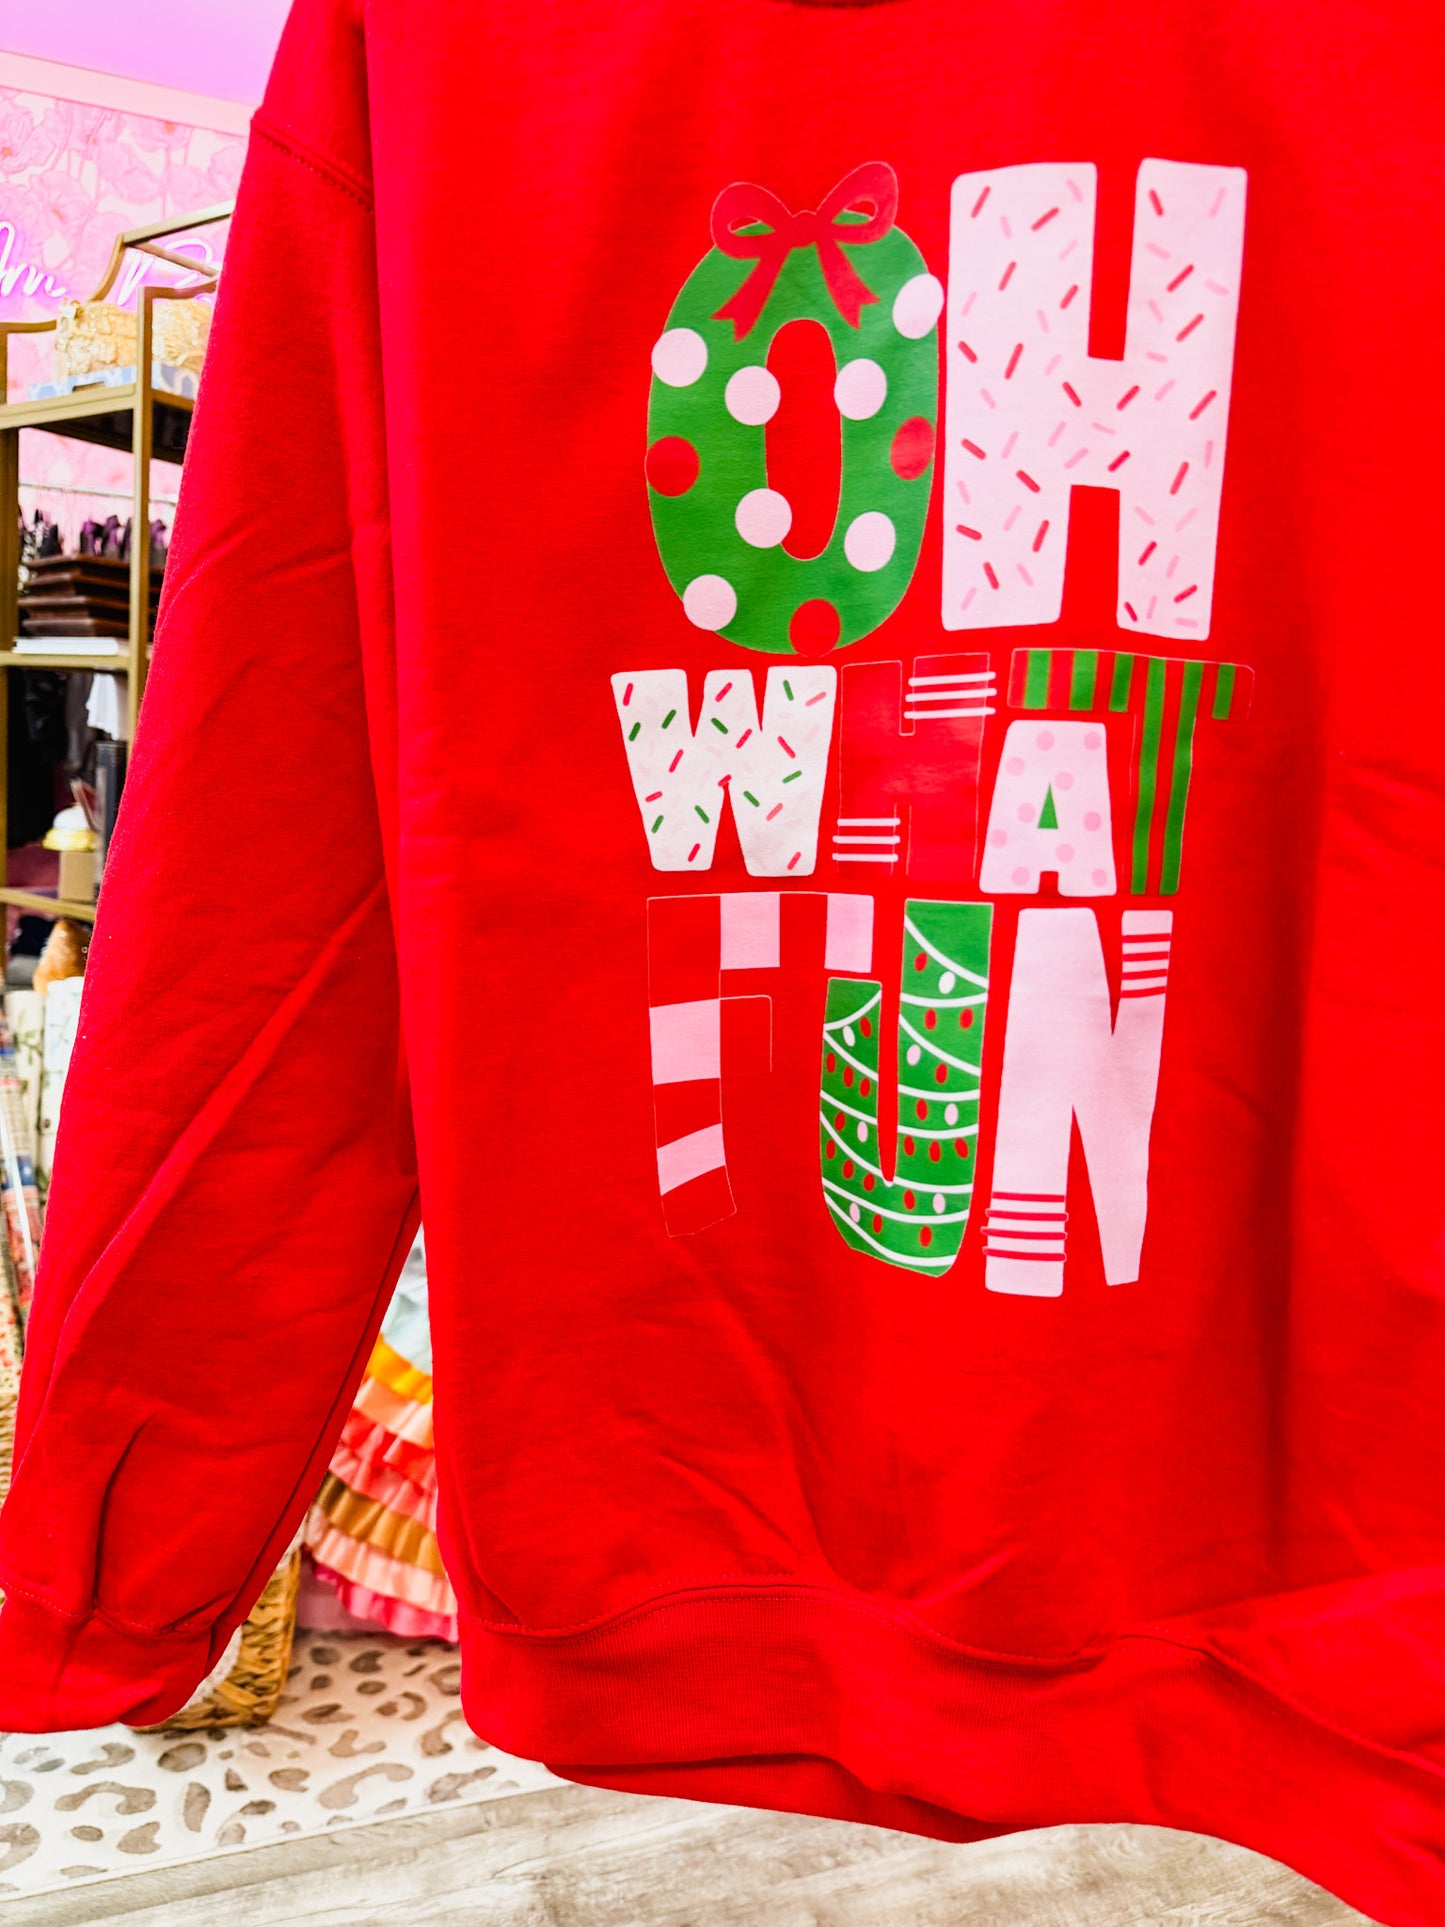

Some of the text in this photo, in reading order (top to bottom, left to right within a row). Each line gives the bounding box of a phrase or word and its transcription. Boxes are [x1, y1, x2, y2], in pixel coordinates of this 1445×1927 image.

[645, 158, 1248, 658] OH
[611, 647, 1254, 897] WHAT
[646, 891, 1173, 1297] FUN
